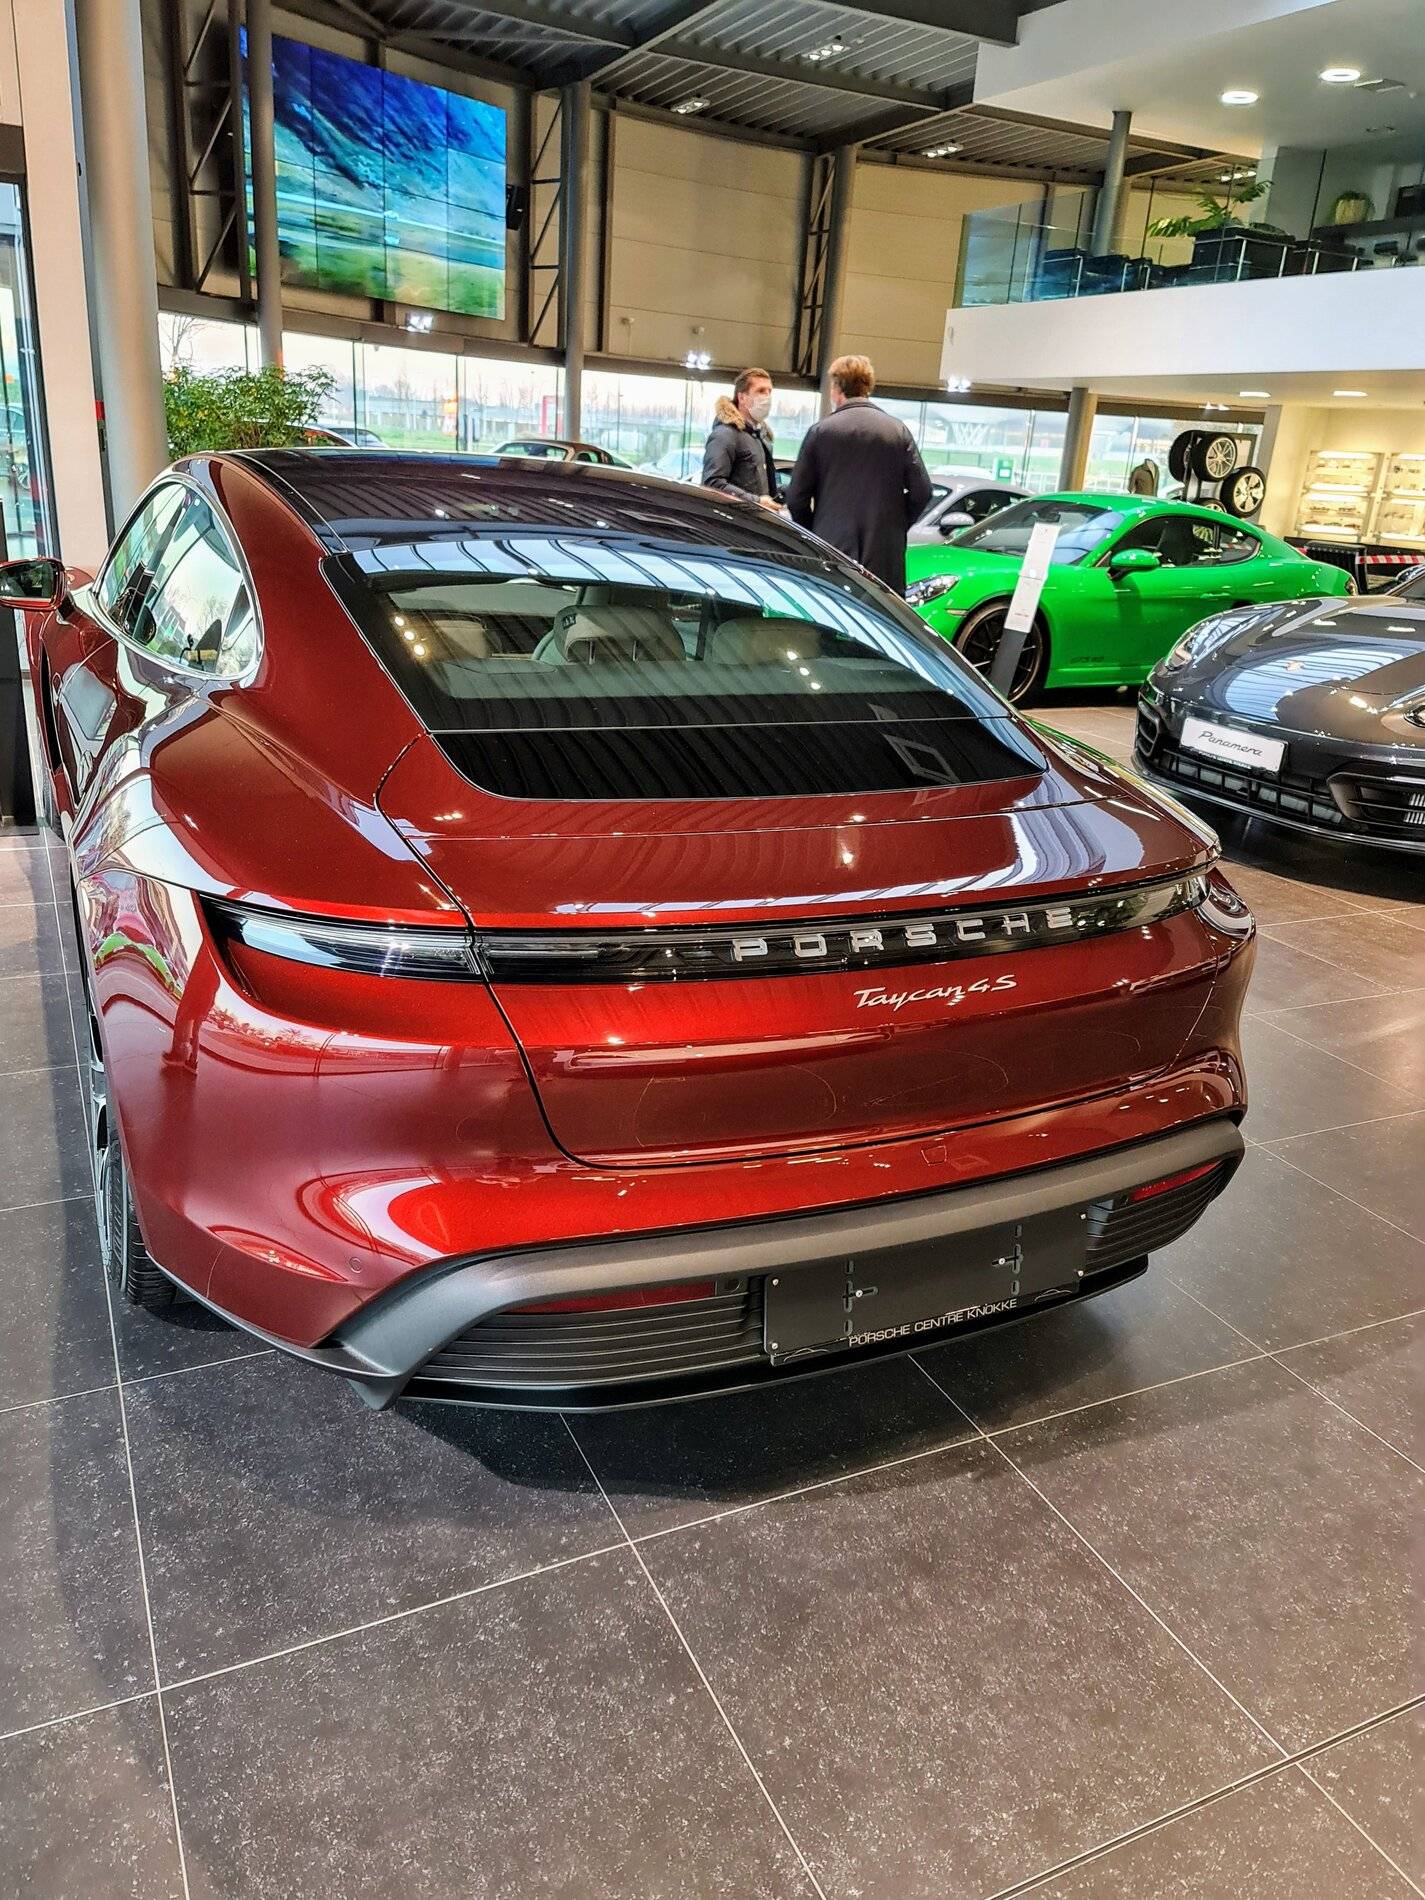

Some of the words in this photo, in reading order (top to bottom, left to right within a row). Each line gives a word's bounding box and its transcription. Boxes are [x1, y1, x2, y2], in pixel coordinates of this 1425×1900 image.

[1198, 730, 1263, 756] Panamera
[731, 906, 1075, 962] PORSCHE
[853, 986, 966, 1012] Taycan
[967, 974, 1018, 993] 4S
[849, 1324, 911, 1347] PORSCHE
[914, 1312, 964, 1332] CENTRE
[967, 1298, 1018, 1320] KNOKKE
